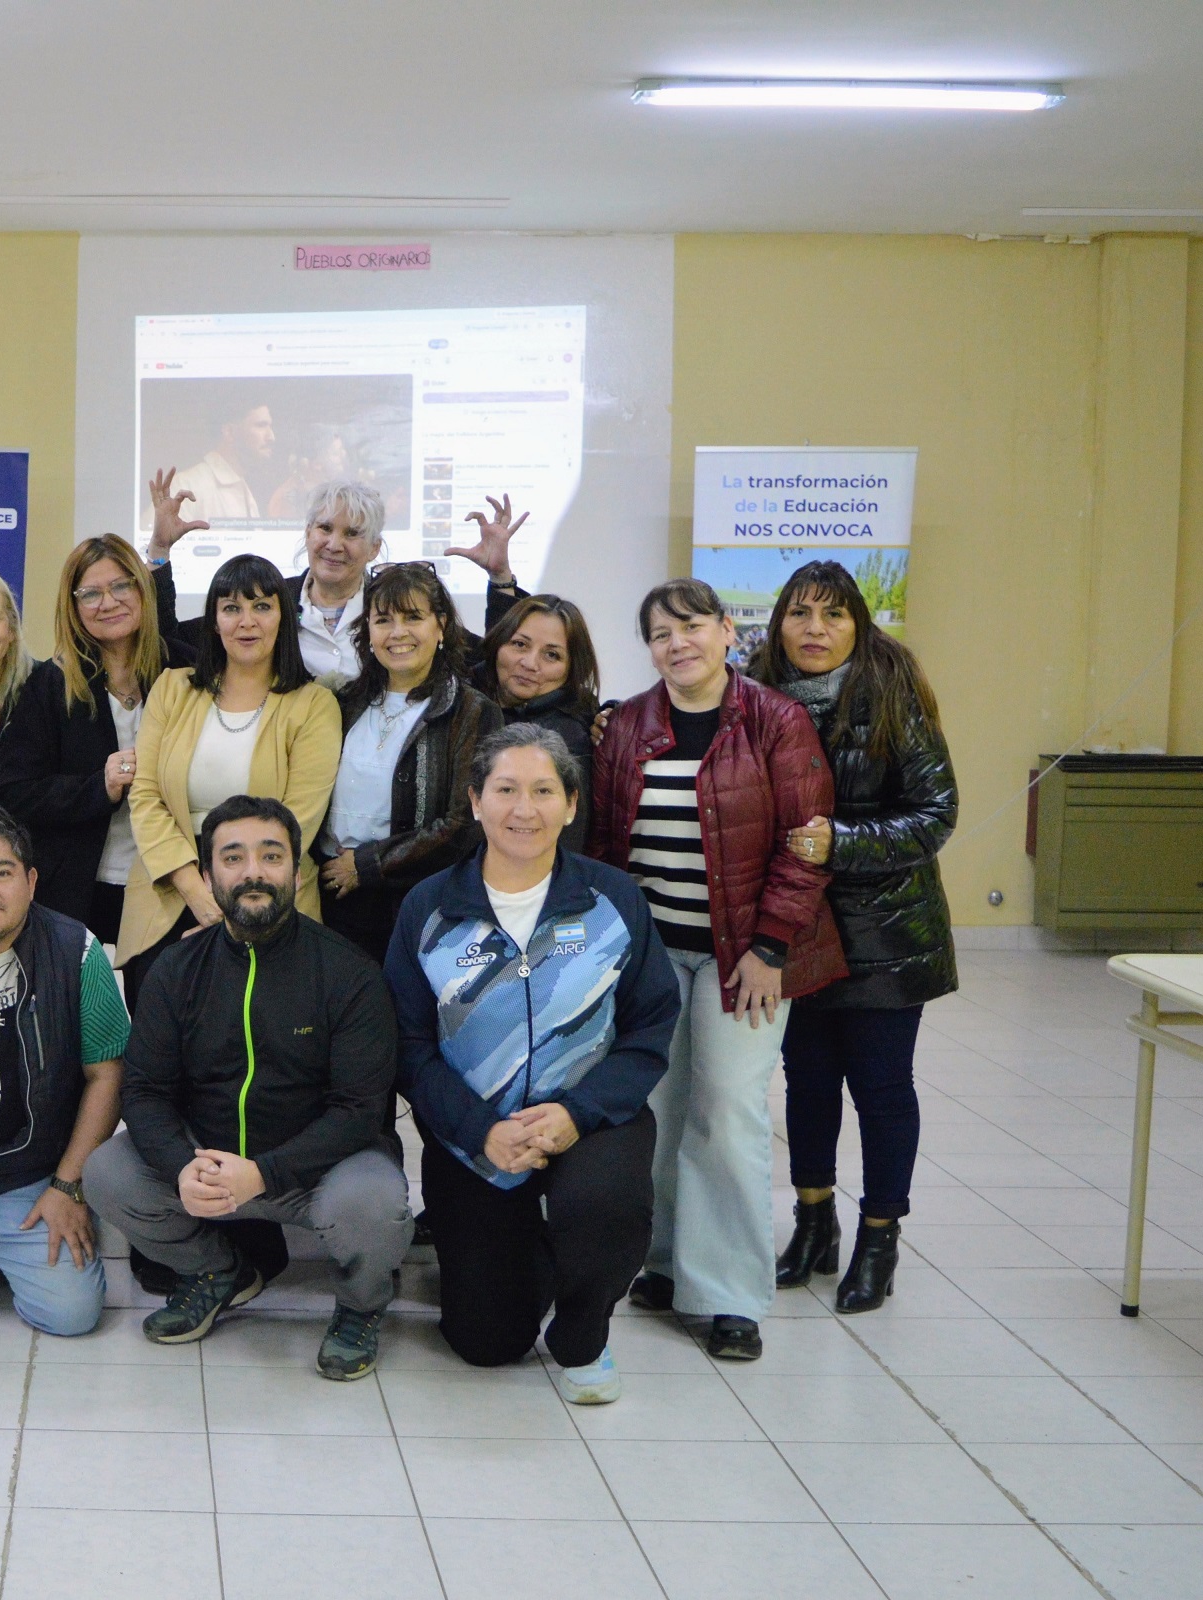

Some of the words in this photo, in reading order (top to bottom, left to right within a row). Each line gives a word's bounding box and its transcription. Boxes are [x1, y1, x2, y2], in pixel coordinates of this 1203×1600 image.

[296, 247, 352, 269] PUEBLOS
[722, 475, 743, 488] La
[748, 474, 889, 489] transformación
[734, 499, 758, 513] de
[763, 499, 778, 513] la
[784, 498, 879, 513] Educación
[734, 523, 773, 537] NOS
[778, 523, 874, 537] CONVOCA
[552, 941, 586, 957] ARG
